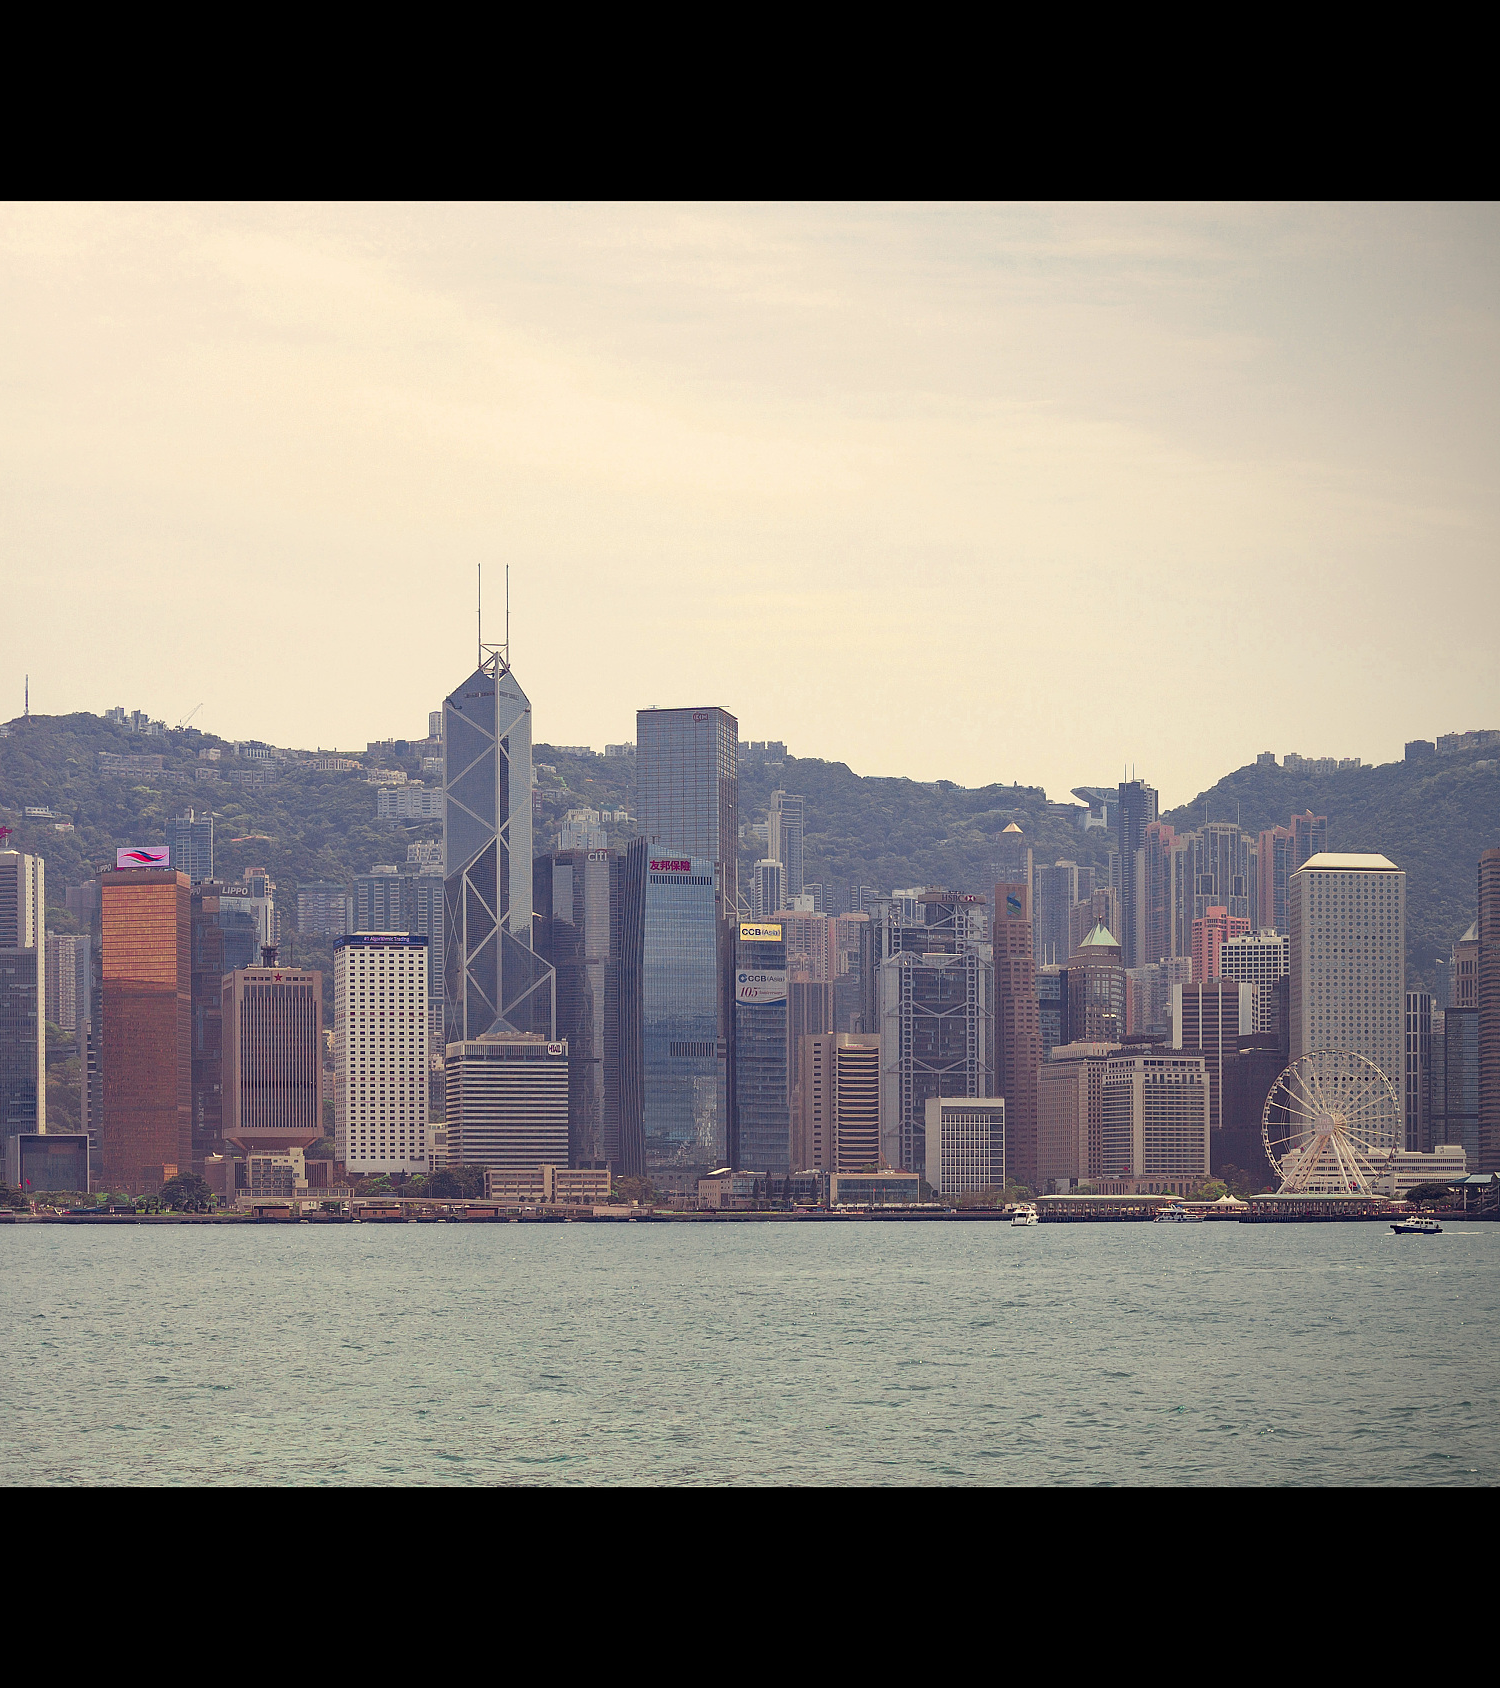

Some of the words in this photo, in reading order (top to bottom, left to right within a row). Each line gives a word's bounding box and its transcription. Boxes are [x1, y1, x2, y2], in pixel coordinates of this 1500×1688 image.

[587, 850, 608, 862] citi
[649, 859, 691, 872] 友邦保險
[221, 886, 248, 896] LIPPO
[741, 928, 761, 936] CCB
